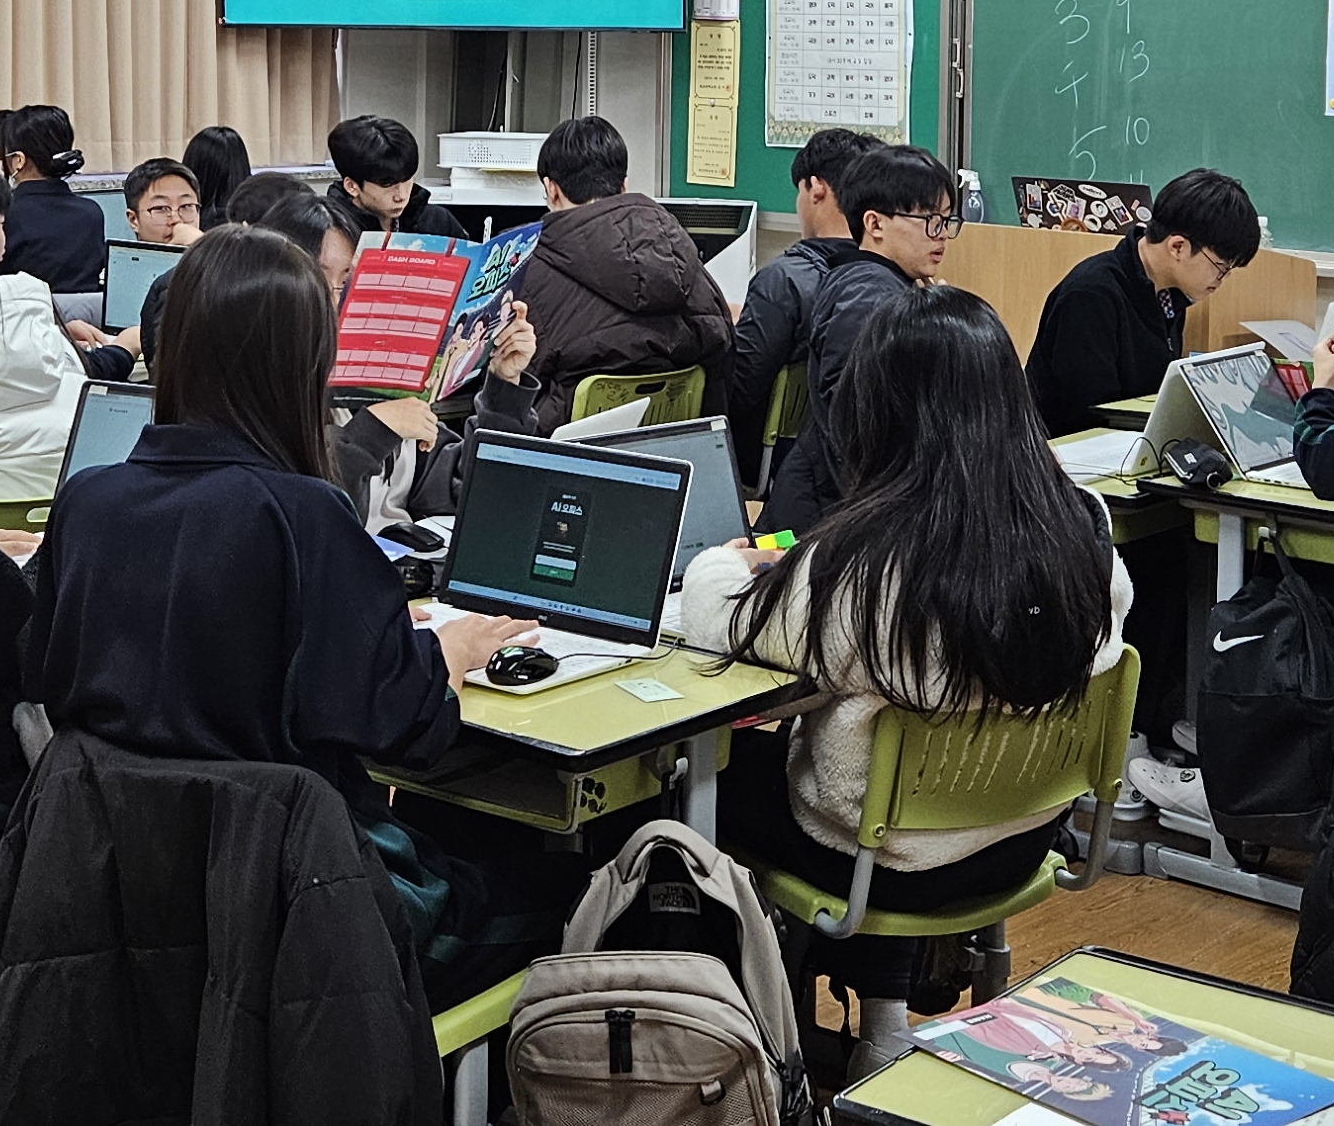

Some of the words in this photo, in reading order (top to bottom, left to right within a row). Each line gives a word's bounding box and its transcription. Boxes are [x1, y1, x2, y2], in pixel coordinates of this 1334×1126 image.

[1120, 41, 1151, 83] 13
[1068, 125, 1107, 181] 5
[1124, 116, 1150, 146] 10
[467, 263, 512, 302] 오피스
[1134, 1060, 1241, 1112] 오피스
[1205, 1087, 1260, 1121] AI
